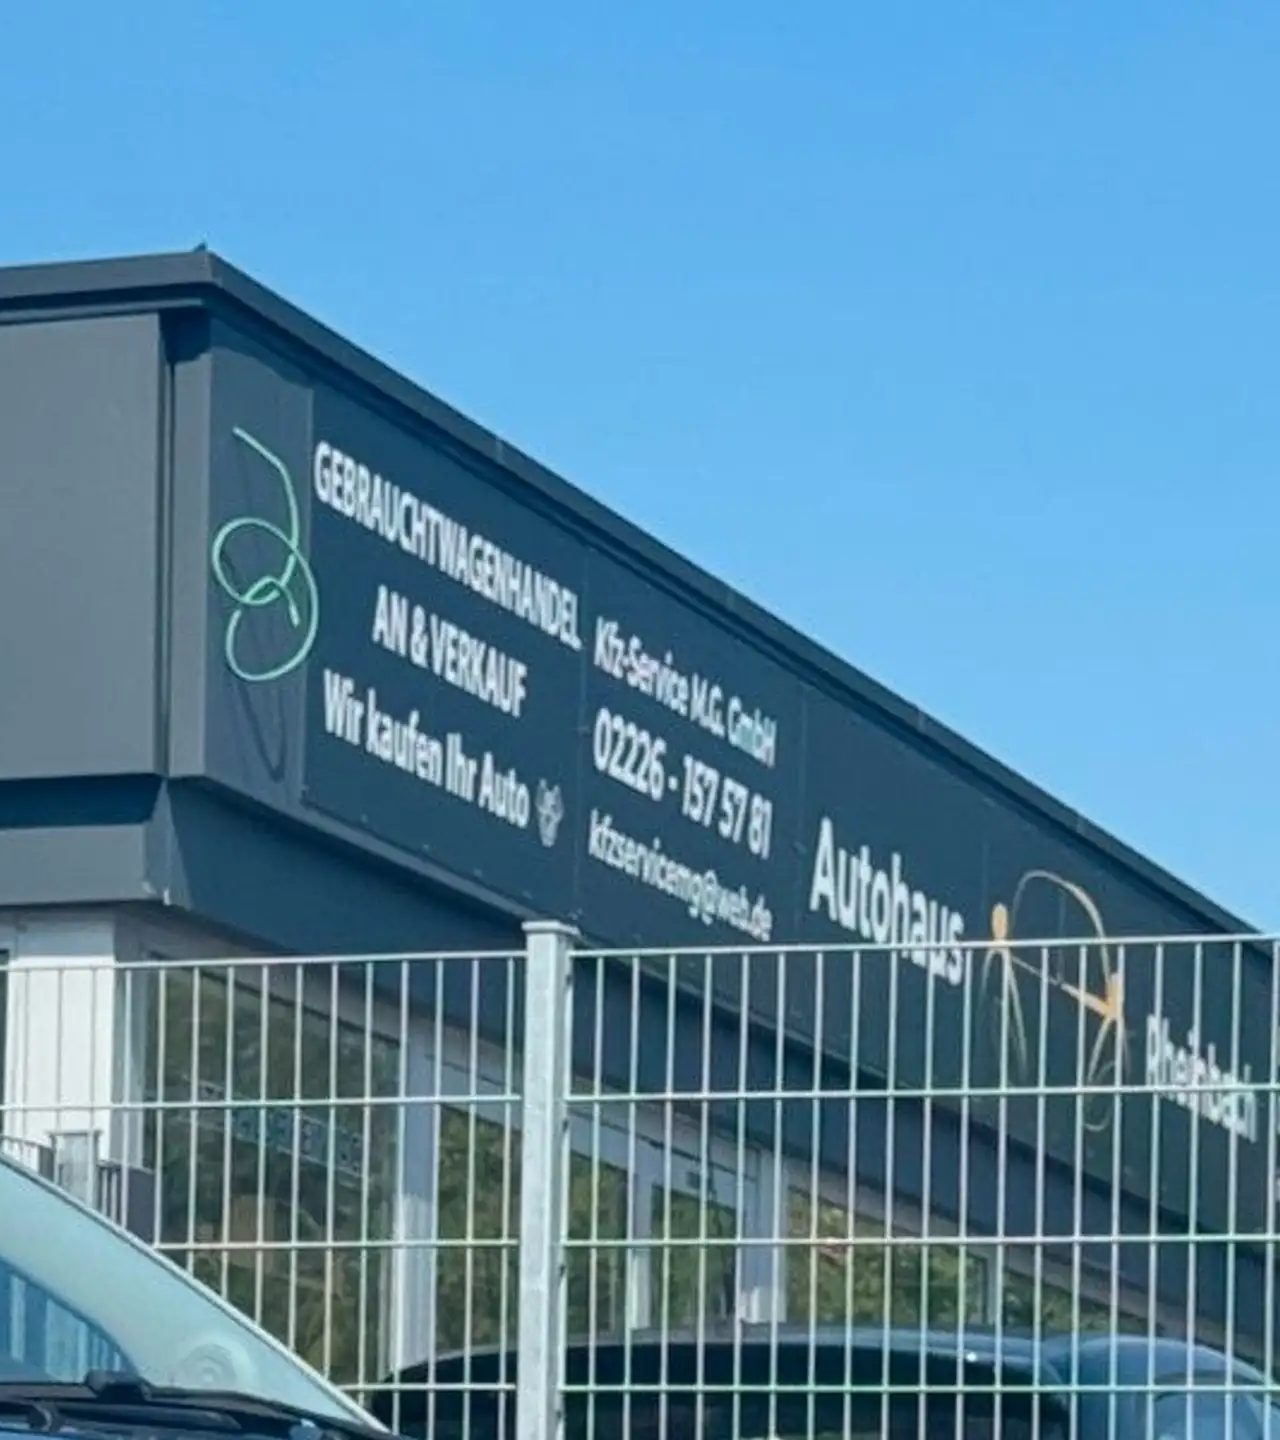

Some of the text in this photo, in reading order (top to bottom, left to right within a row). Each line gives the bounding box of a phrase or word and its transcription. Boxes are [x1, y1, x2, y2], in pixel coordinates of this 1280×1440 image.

[314, 440, 582, 652] GEBRAUCHTWAGENHANDEL
[371, 583, 528, 718] AN & VERKAUF
[594, 615, 689, 718] Kfz-Service
[727, 696, 778, 769] GmbH
[323, 668, 530, 830] Wir kaufen Ihr Auto
[593, 707, 667, 802] 02226
[682, 753, 720, 829] 157
[718, 776, 749, 844] 57
[748, 792, 773, 861] 81
[809, 816, 965, 987] Autohaus
